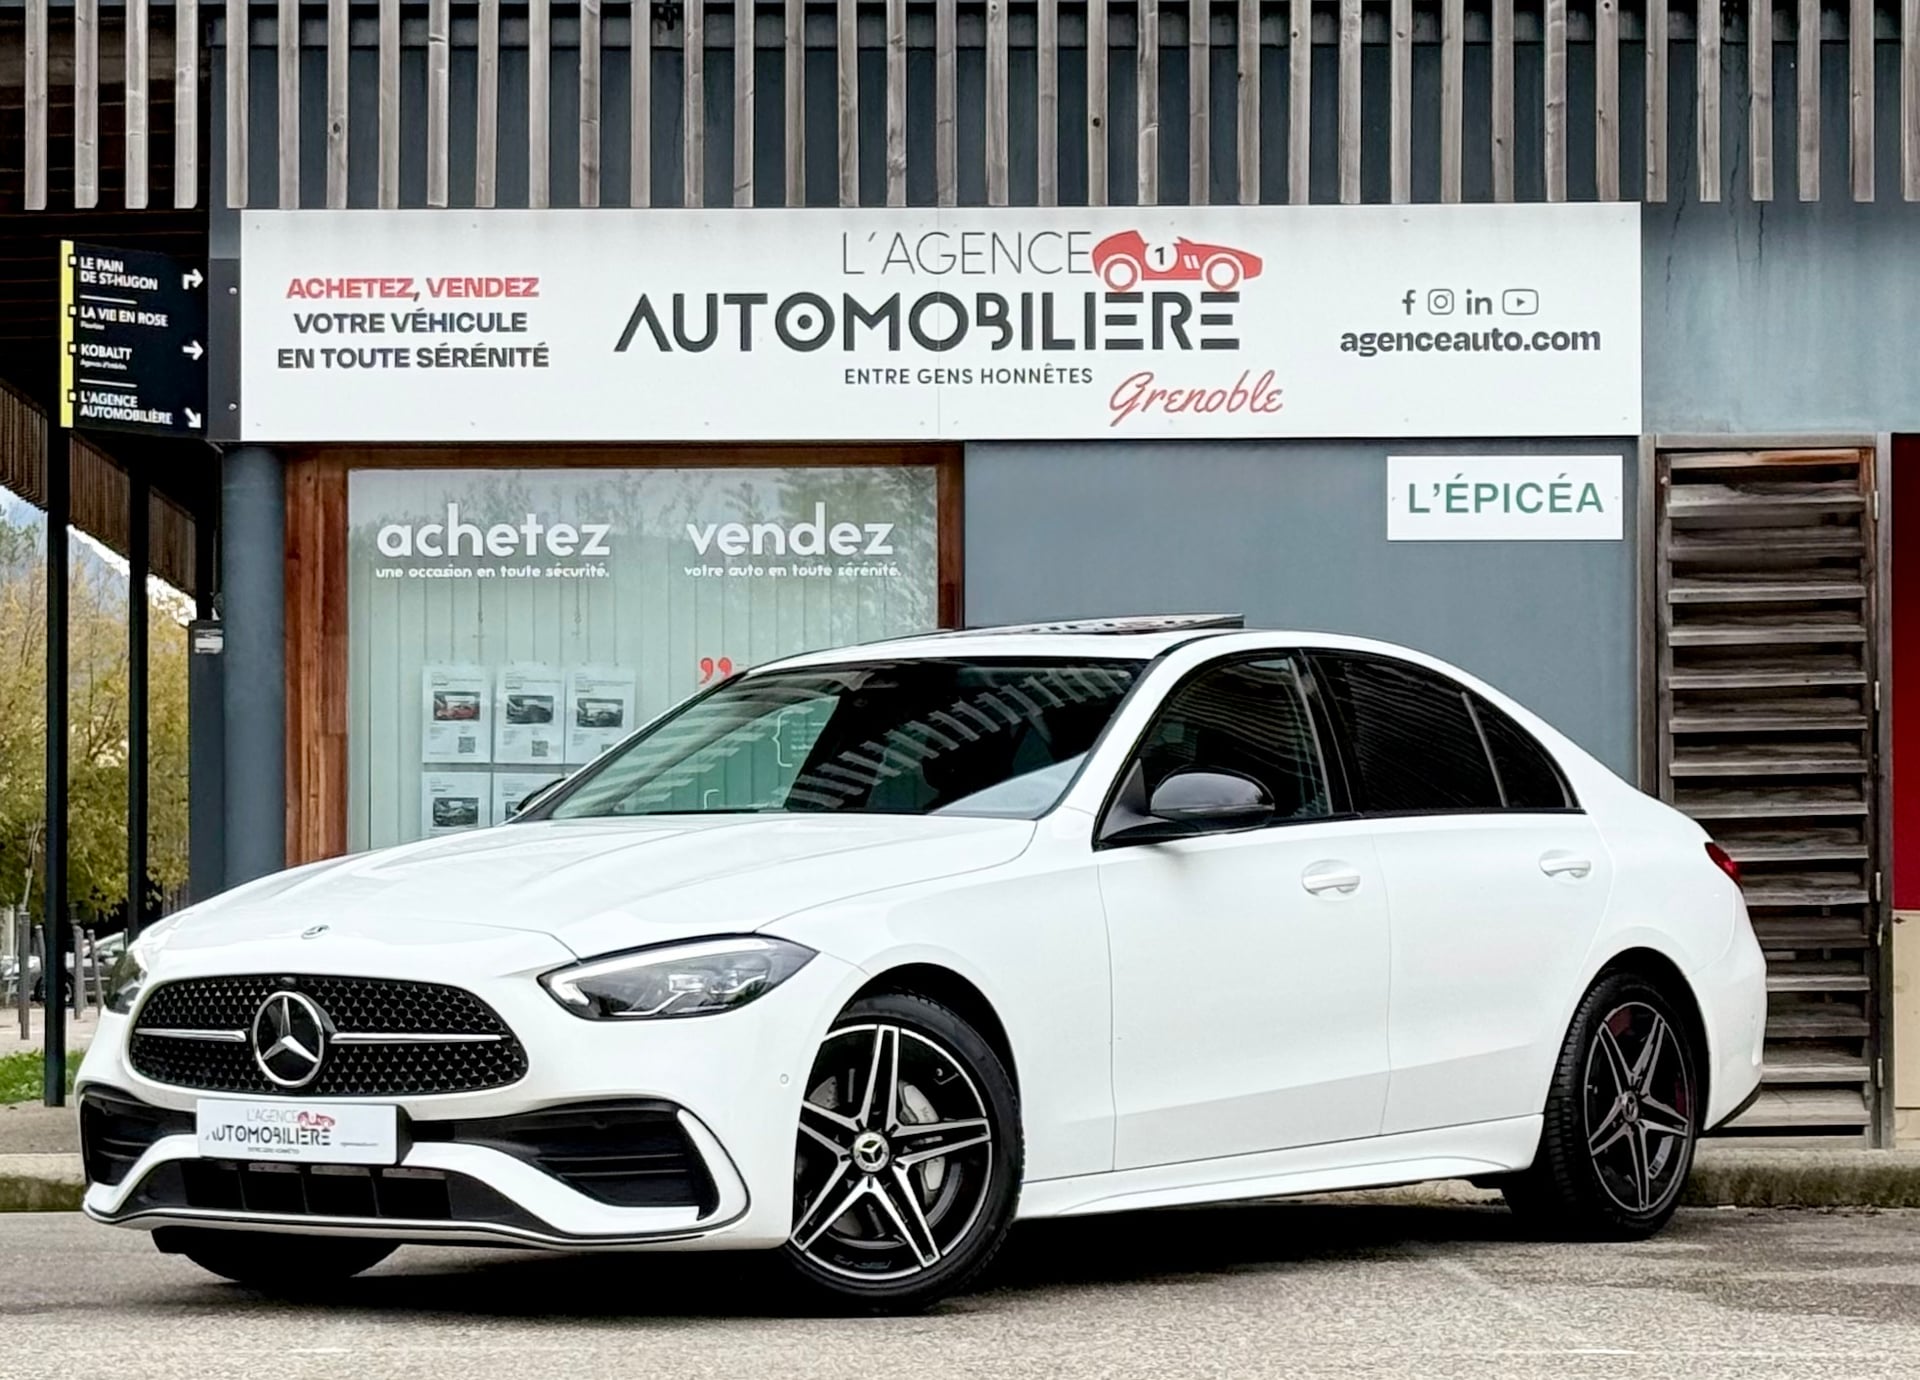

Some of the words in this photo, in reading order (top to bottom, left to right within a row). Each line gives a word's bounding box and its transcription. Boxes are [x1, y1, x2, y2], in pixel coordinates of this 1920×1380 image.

[842, 231, 1092, 275] L'AGENCE
[1154, 246, 1165, 265] 1
[80, 256, 94, 270] LE
[97, 258, 124, 273] PAIN
[80, 271, 97, 284] DE
[286, 277, 421, 302] ACHETEZ,
[426, 277, 539, 298] VENDEZ
[80, 305, 96, 319] LA
[98, 307, 117, 322] VIE
[119, 309, 135, 323] EN
[137, 312, 168, 327] ROSE
[294, 312, 385, 333] VOTRE
[390, 307, 528, 333] VÉHICULE
[81, 343, 132, 361] KOBALTT
[1340, 327, 1601, 357] agenceauto.com
[277, 348, 315, 369] EN
[319, 347, 411, 369] TOUTE
[416, 342, 549, 369] SÉRÉNITÉ
[844, 368, 910, 385] ENTRE
[917, 368, 973, 385] GENS
[980, 363, 1093, 385] HONNÊTES
[81, 390, 138, 408] L'AGENCE
[1108, 369, 1284, 427] Grenoble
[80, 404, 173, 425] AUTOMOBILIÈRE
[1408, 473, 1604, 514] L'ÉPICÉA
[376, 502, 611, 557] achetez
[686, 502, 895, 556] vendez
[376, 567, 404, 579] une
[408, 563, 473, 579] occasion
[477, 567, 496, 579] en
[500, 564, 541, 579] toute
[545, 562, 610, 579] sécurité.
[684, 564, 724, 578] votre
[728, 564, 764, 578] auto
[769, 567, 788, 578] en
[792, 564, 833, 578] toute
